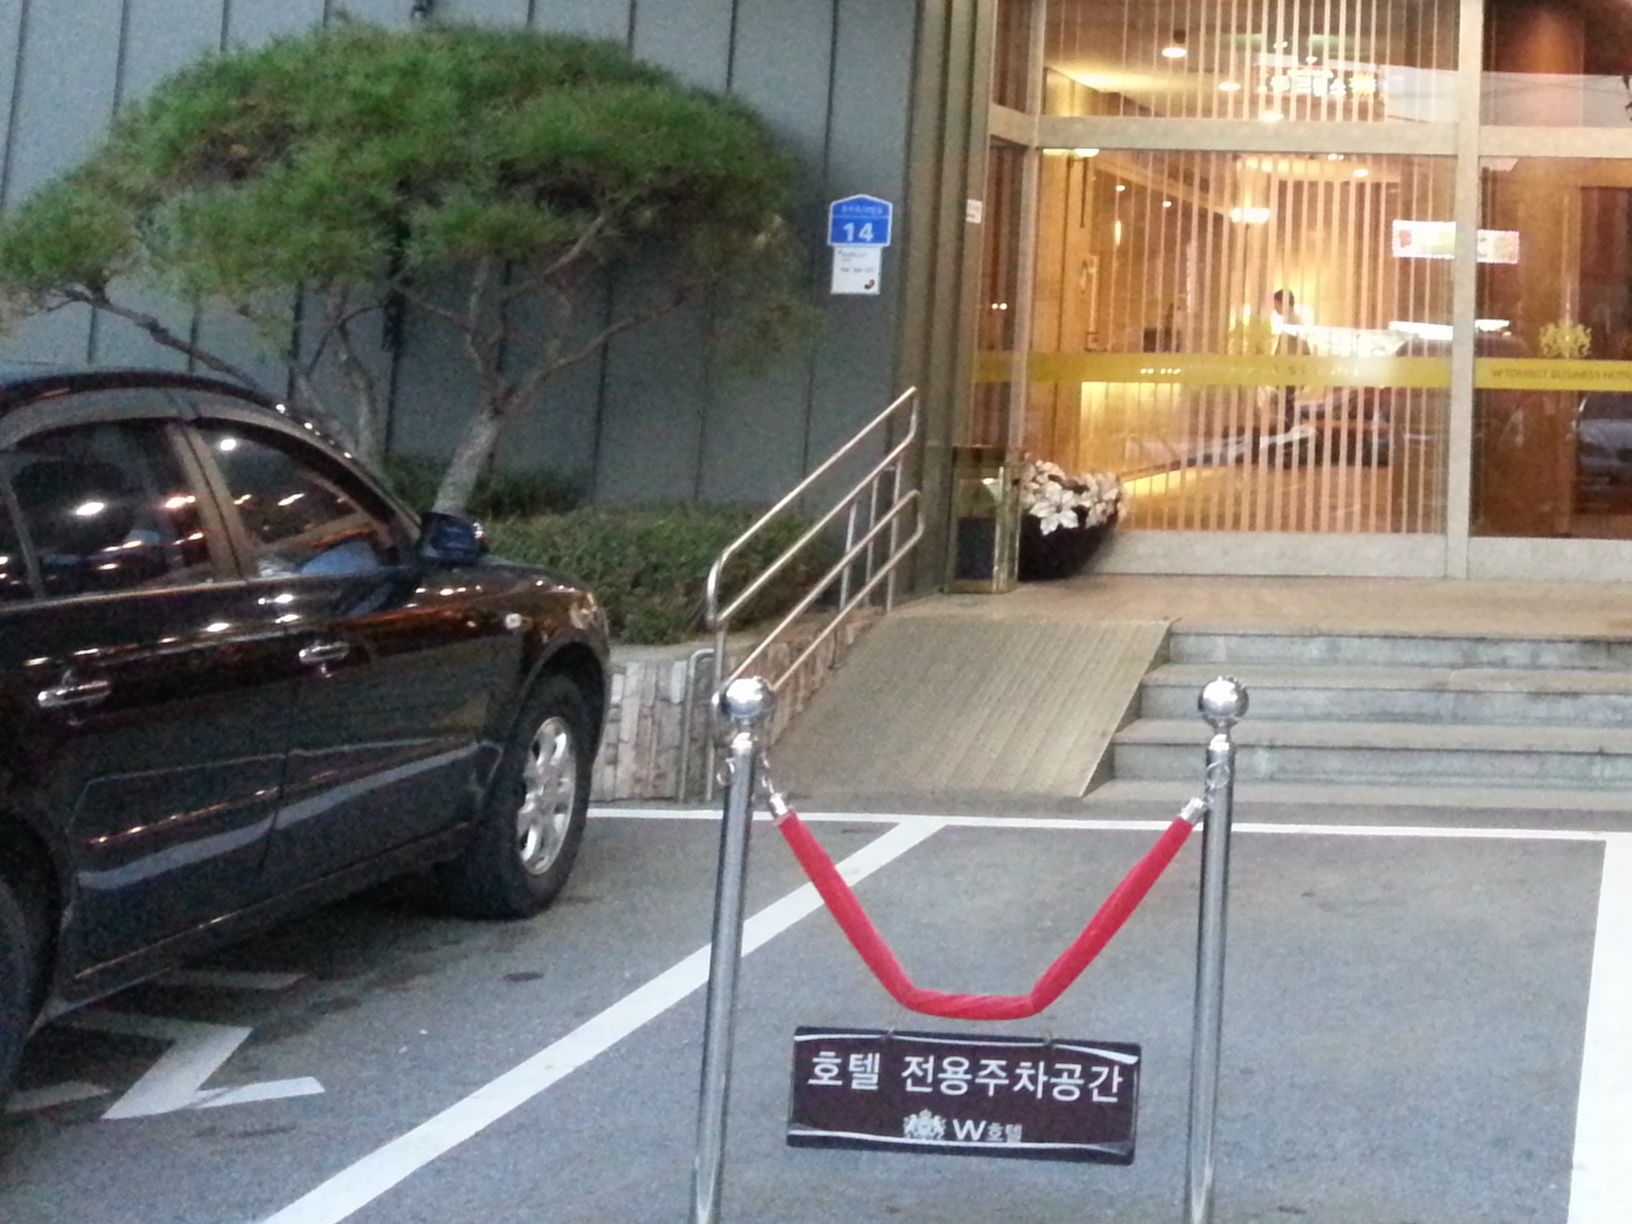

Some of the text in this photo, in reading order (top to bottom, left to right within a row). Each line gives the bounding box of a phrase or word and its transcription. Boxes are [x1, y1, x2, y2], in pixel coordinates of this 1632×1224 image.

[843, 222, 875, 242] 14
[808, 1050, 1123, 1103] 호텔 전용주차공간
